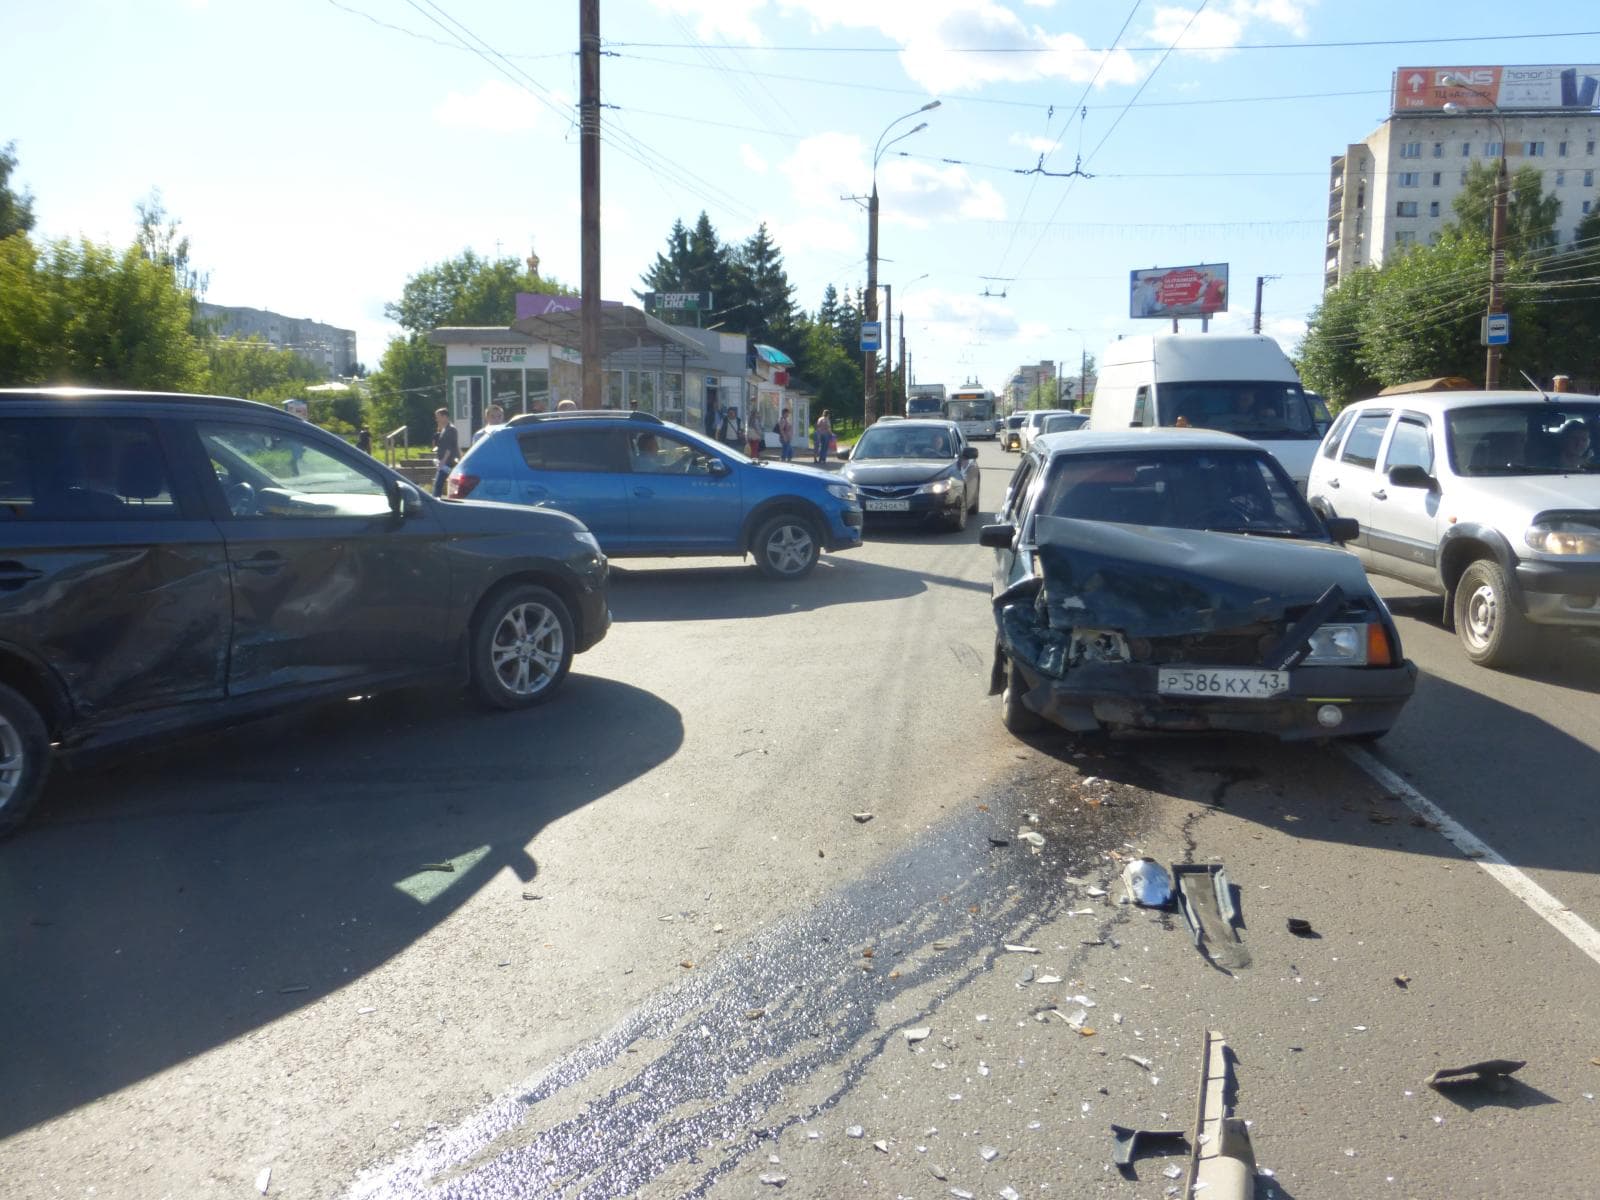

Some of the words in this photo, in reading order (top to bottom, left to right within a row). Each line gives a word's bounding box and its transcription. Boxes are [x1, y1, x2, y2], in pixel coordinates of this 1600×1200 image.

[664, 293, 700, 301] COFFEE
[491, 347, 528, 355] COFFEE
[491, 355, 512, 363] LIKE
